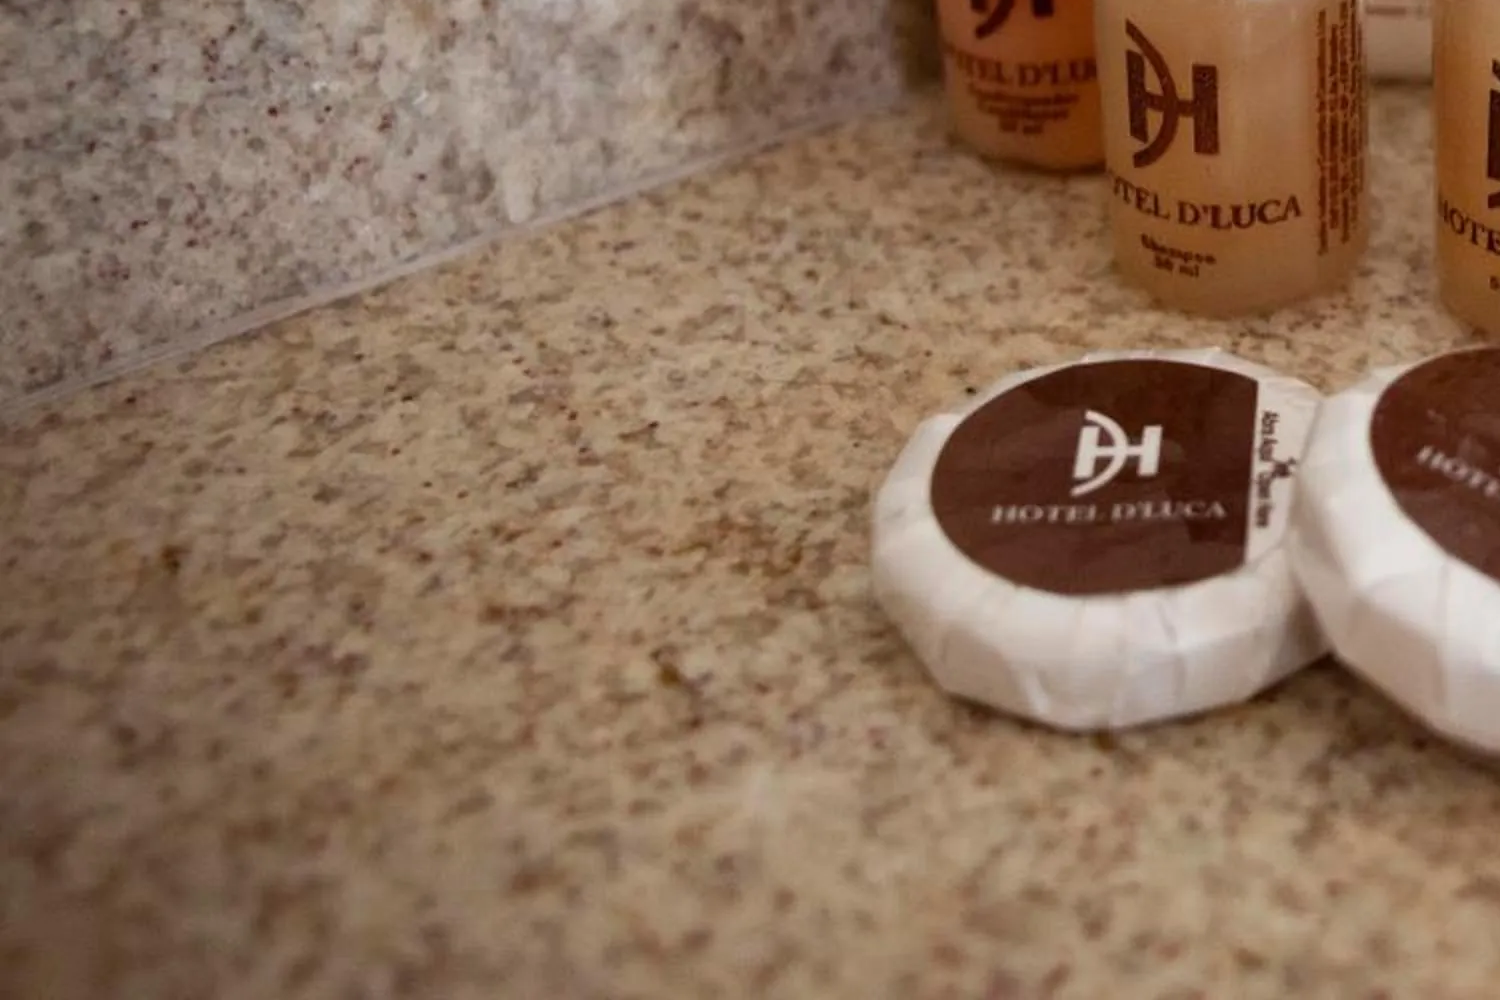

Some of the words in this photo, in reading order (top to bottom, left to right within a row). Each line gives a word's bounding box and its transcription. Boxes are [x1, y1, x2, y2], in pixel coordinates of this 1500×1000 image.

[1178, 195, 1302, 230] D'LUCA
[990, 502, 1098, 525] HOTEL
[1110, 500, 1227, 524] D'LUCA
